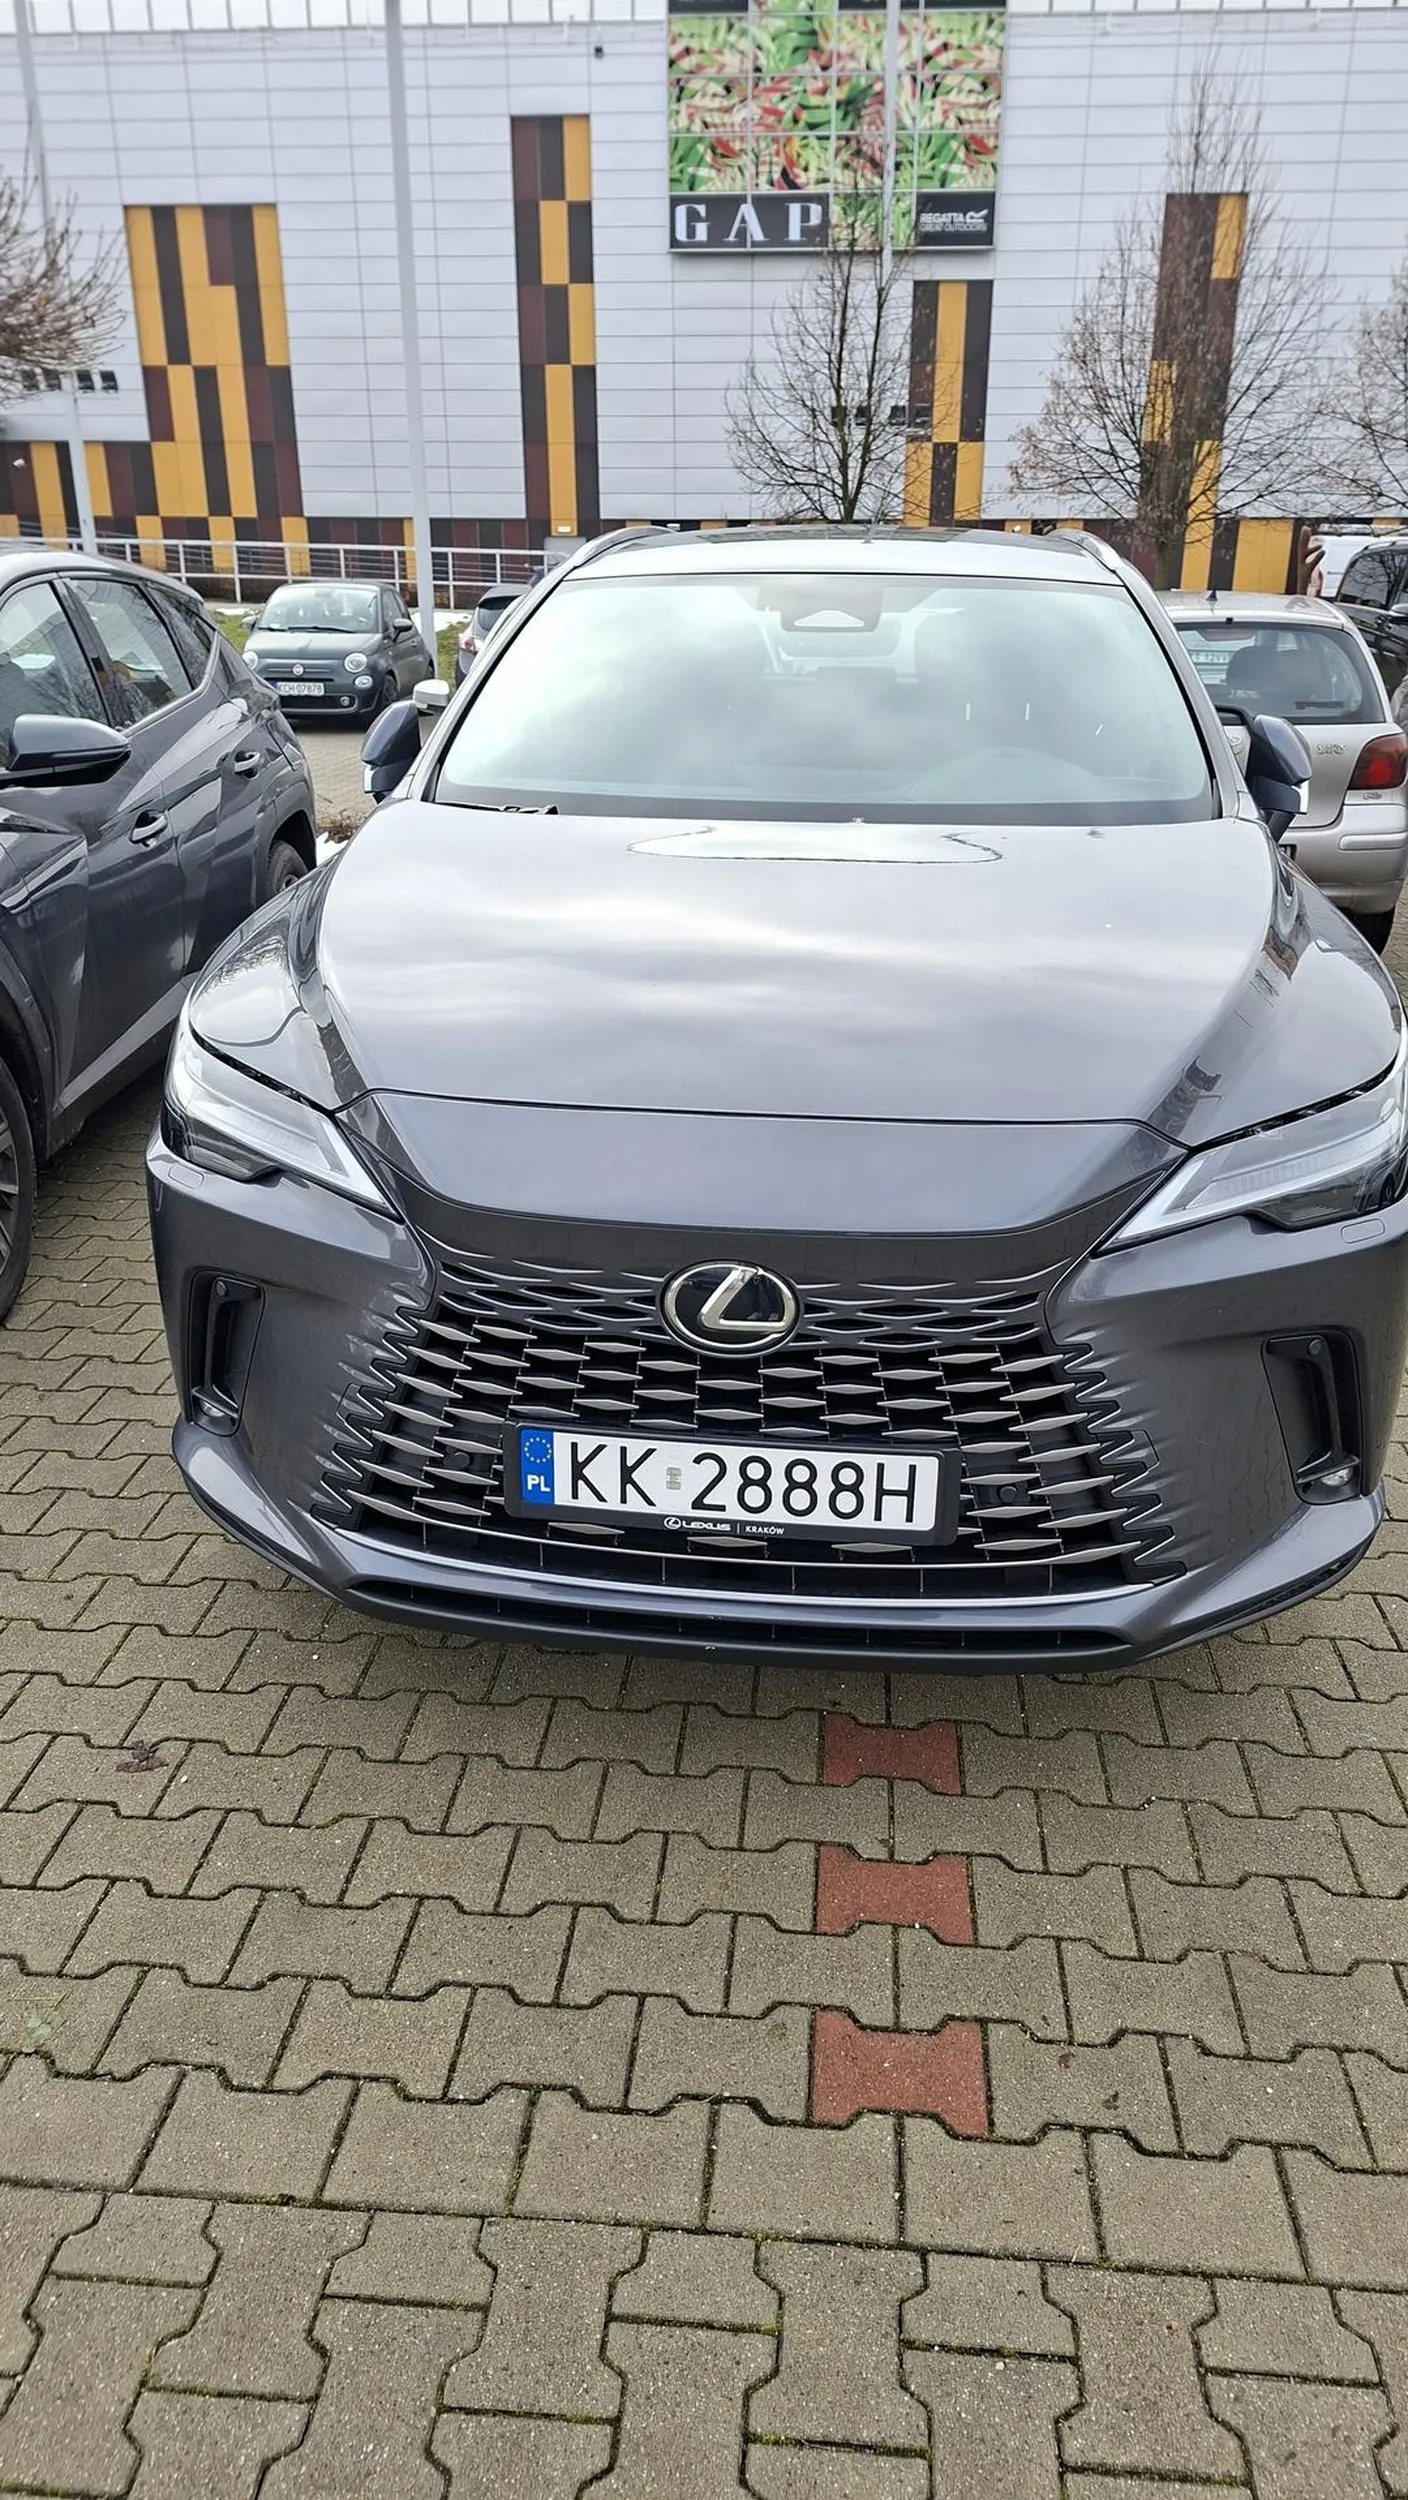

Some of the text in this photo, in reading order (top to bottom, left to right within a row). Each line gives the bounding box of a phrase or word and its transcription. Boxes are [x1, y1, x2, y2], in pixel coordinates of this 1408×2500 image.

[674, 203, 823, 242] GAP
[919, 213, 964, 223] REGATTA
[527, 1474, 551, 1492] PL
[570, 1441, 917, 1524] KK 2888H
[682, 1520, 785, 1535] LEXUS KRAKÓW
